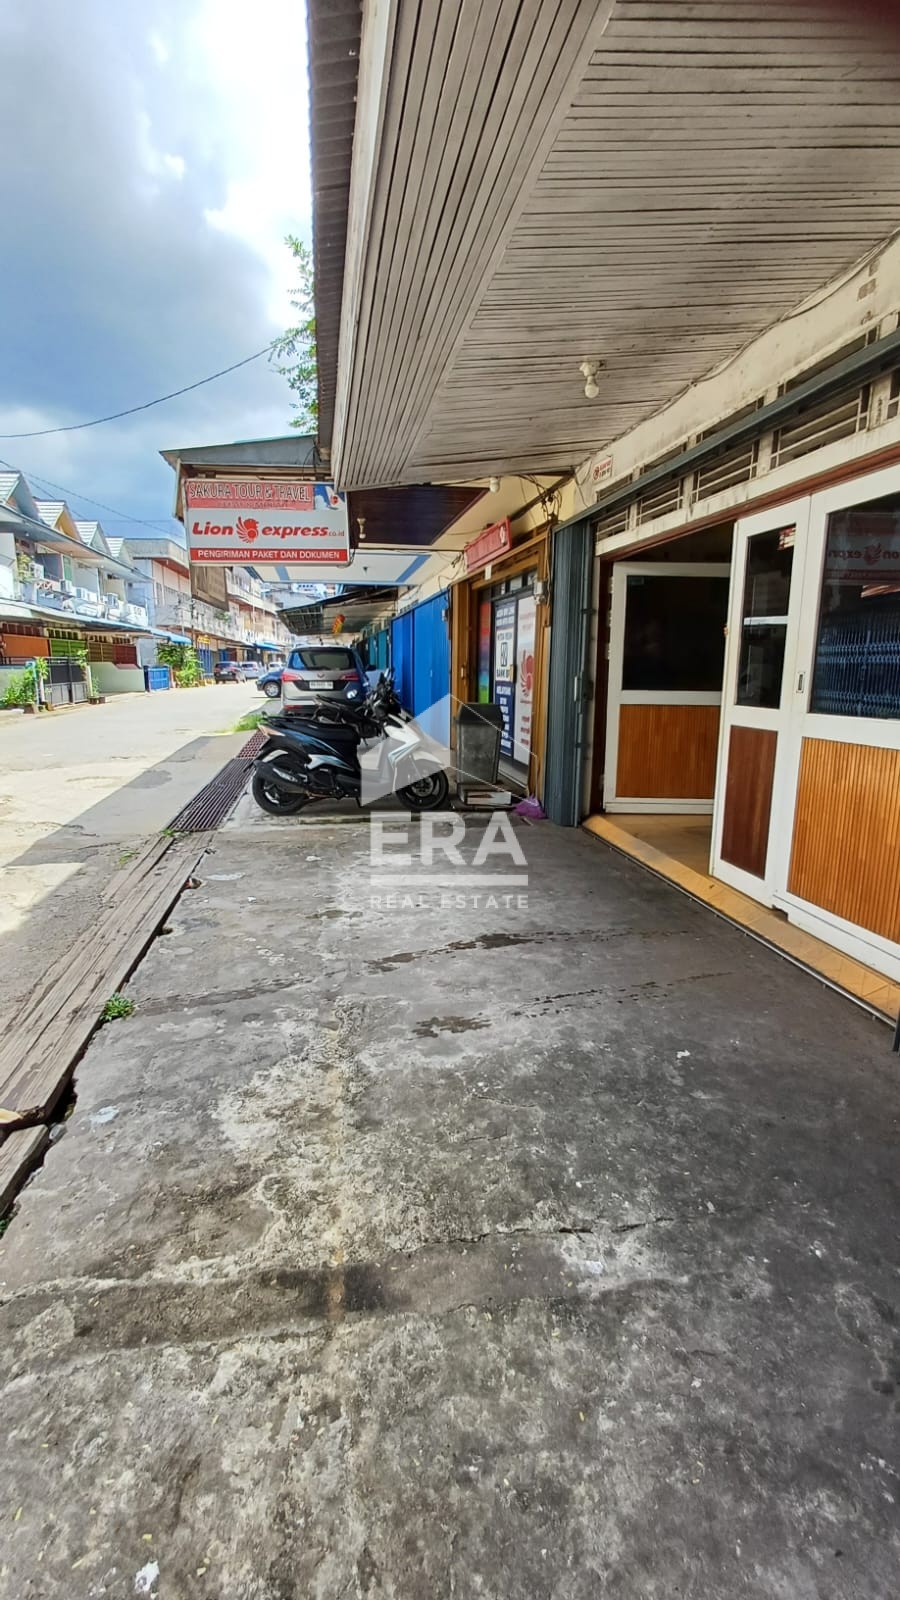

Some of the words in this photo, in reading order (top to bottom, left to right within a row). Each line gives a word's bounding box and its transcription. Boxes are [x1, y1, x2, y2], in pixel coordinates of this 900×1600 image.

[190, 482, 231, 497] SAKURA
[234, 484, 262, 499] TOUR
[264, 486, 273, 500] &
[274, 485, 310, 501] TRAVEL
[192, 522, 234, 535] Lion
[261, 525, 329, 539] express
[197, 549, 250, 558] PENGIRIMAN
[252, 550, 279, 559] PAKET
[280, 550, 298, 560] DAN
[299, 551, 340, 560] DOKUMEN
